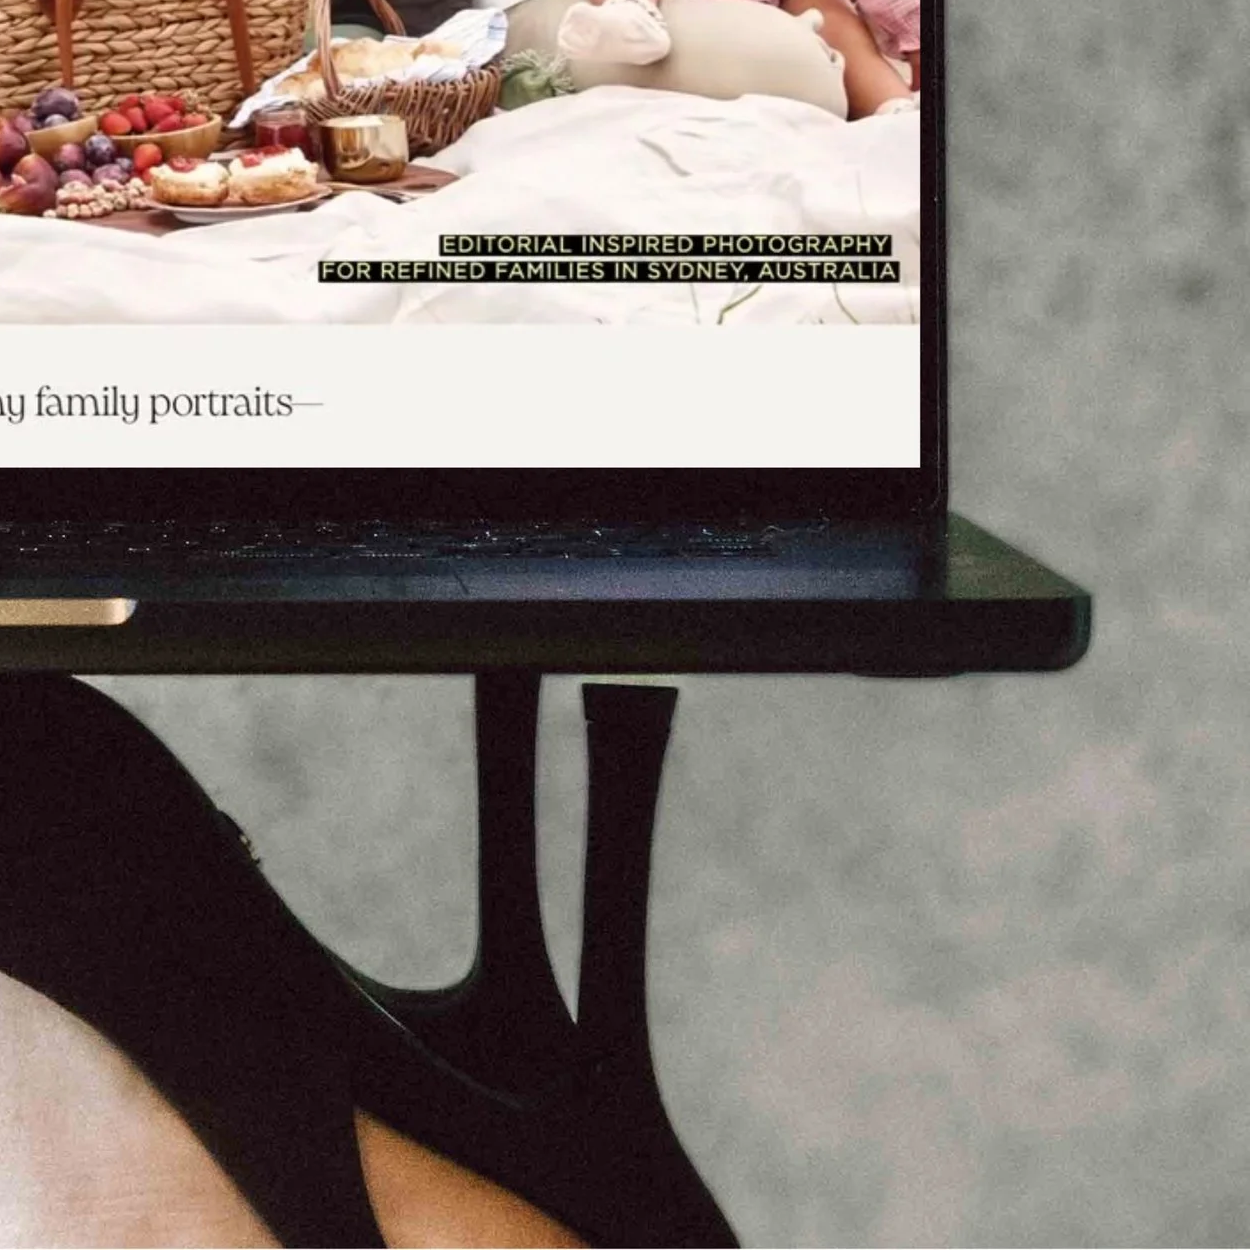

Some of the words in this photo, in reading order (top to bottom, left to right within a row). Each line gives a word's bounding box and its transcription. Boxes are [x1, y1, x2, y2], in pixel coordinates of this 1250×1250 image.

[443, 235, 572, 253] EDITORIAL
[582, 235, 694, 253] INSPIRED
[703, 235, 888, 253] PHOTOGRAPHY
[322, 262, 372, 280] FOR
[381, 262, 486, 280] REFINED
[495, 262, 606, 280] FAMILIES
[615, 262, 637, 280] IN
[648, 262, 750, 282] SYDNEY,
[758, 262, 897, 280] AUSTRALIA
[35, 384, 140, 425] family
